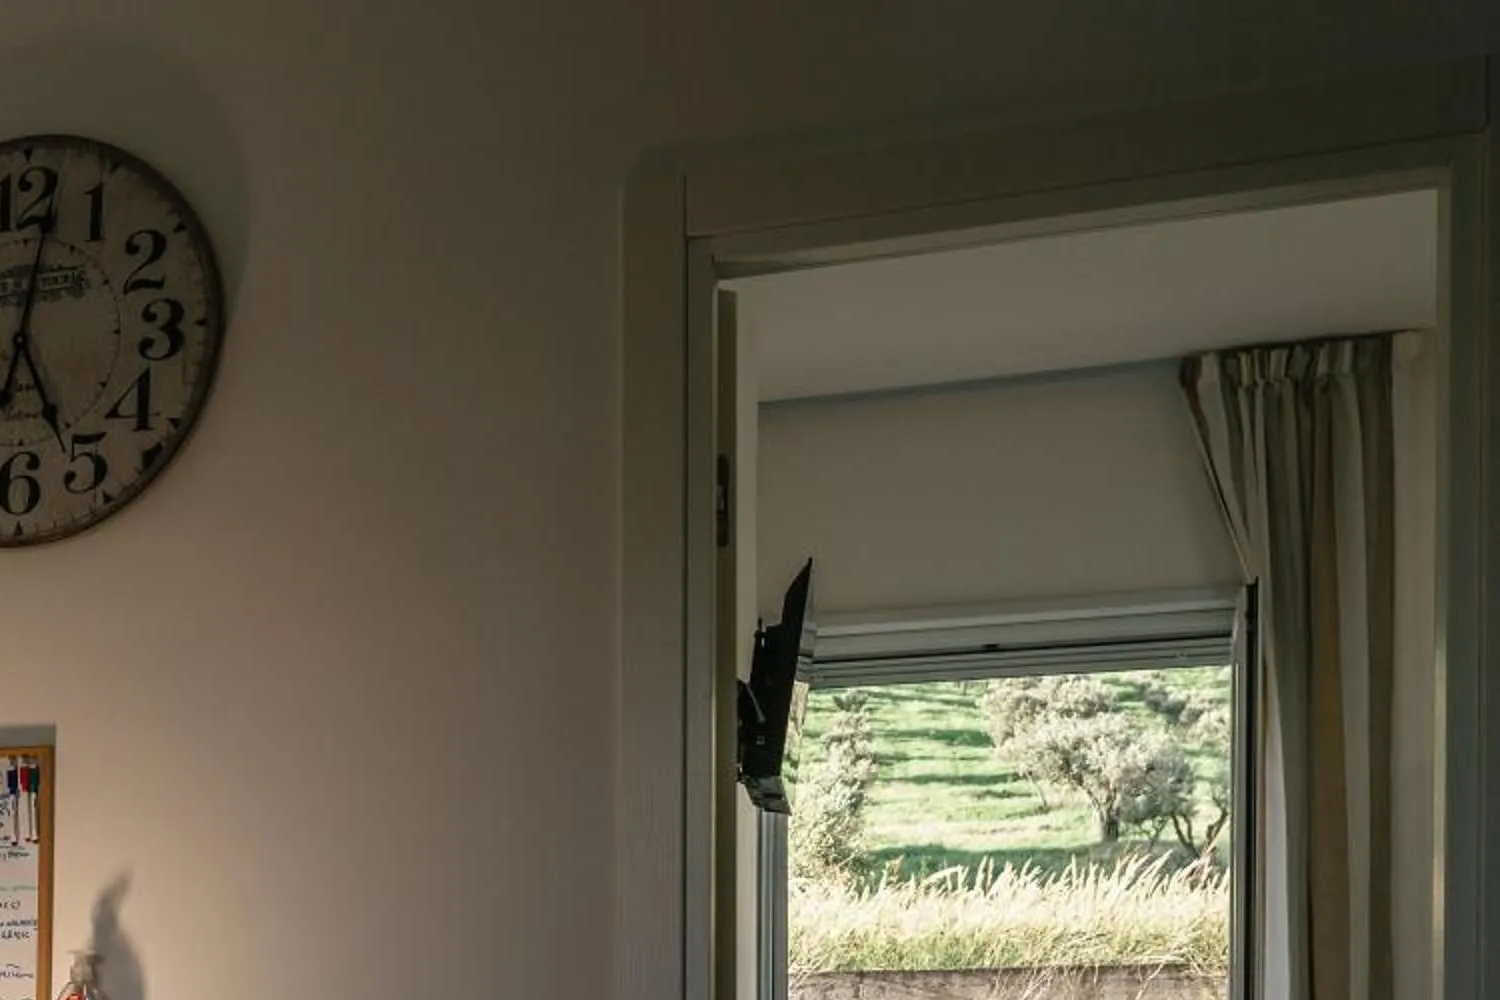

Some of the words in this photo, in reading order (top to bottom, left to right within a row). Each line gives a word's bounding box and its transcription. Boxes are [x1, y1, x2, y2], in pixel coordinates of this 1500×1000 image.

[84, 181, 106, 244] 1
[123, 229, 168, 296] 2
[136, 298, 186, 361] 3
[104, 366, 161, 433] 4
[63, 432, 108, 494] 5
